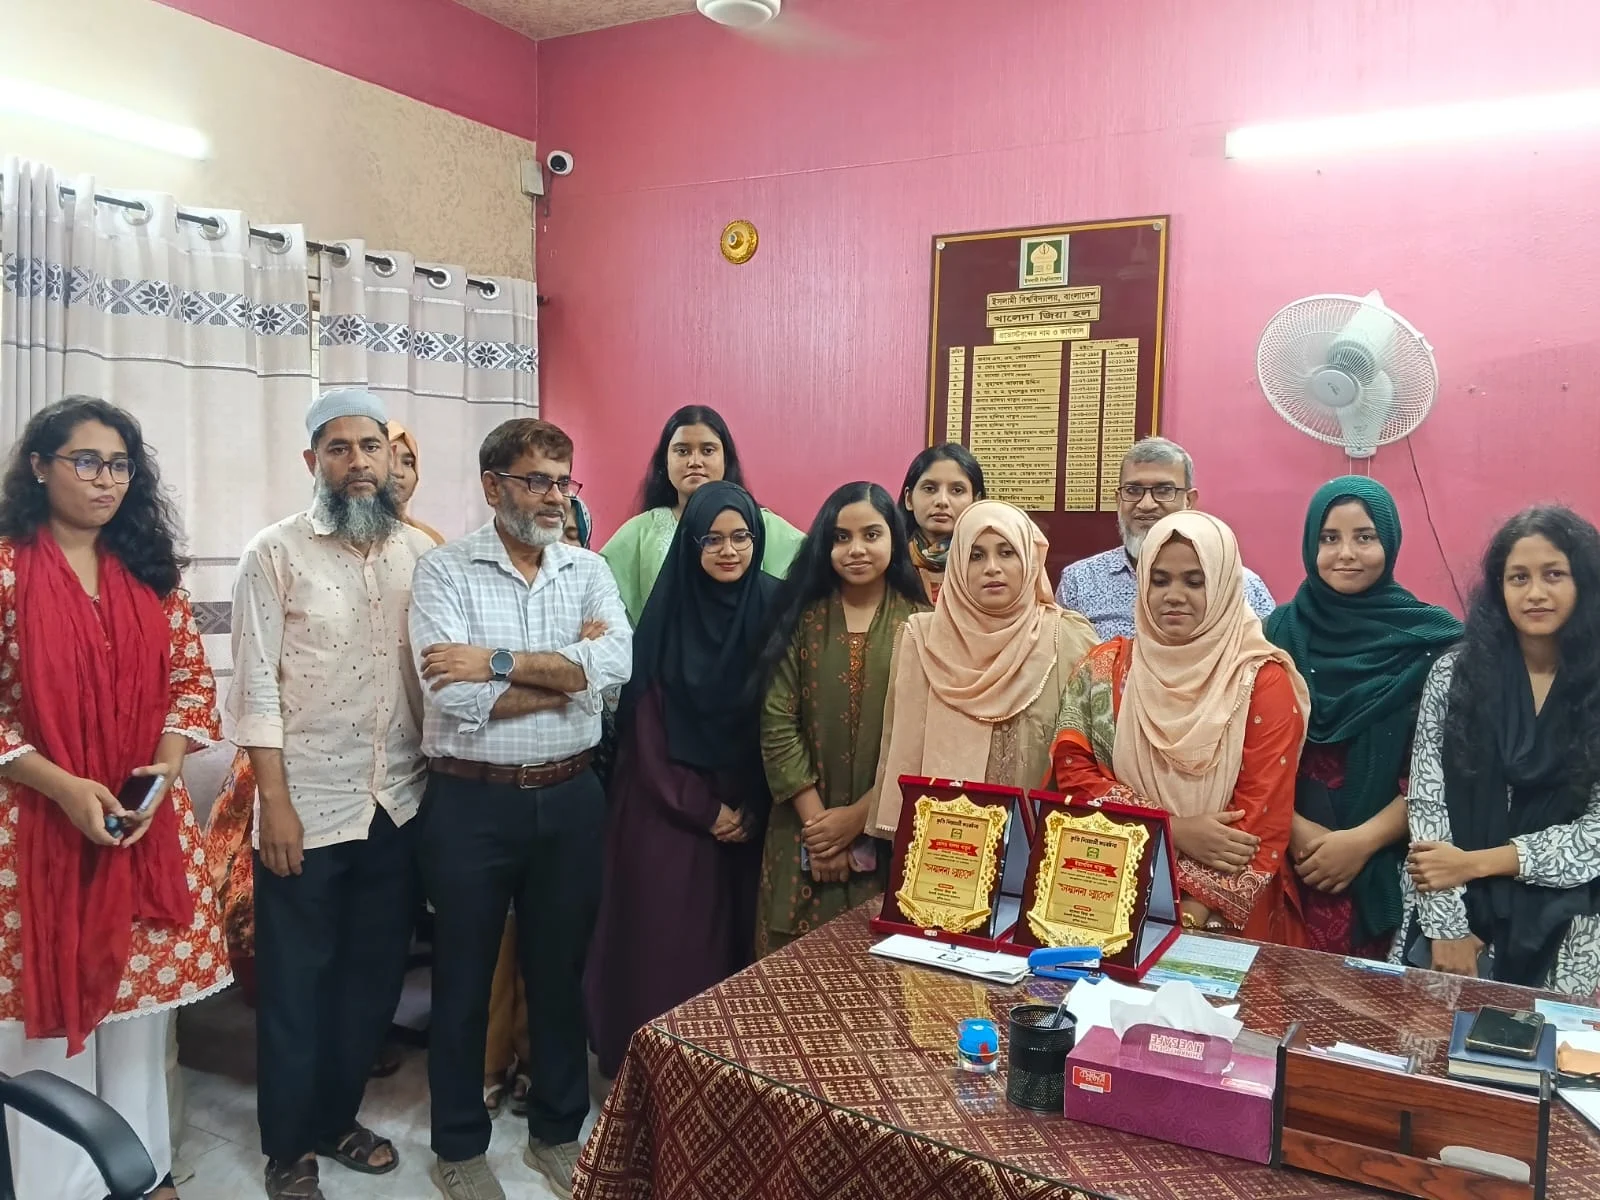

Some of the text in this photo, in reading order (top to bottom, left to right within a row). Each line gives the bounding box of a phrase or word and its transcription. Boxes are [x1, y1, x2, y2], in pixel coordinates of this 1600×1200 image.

[992, 290, 1096, 306] ইসলামী বিশ্ববিদ্যালয়, বাংলাদেশ
[994, 308, 1091, 324] খালেদা জিয়া হল
[1150, 1034, 1204, 1052] LIVE SAFE
